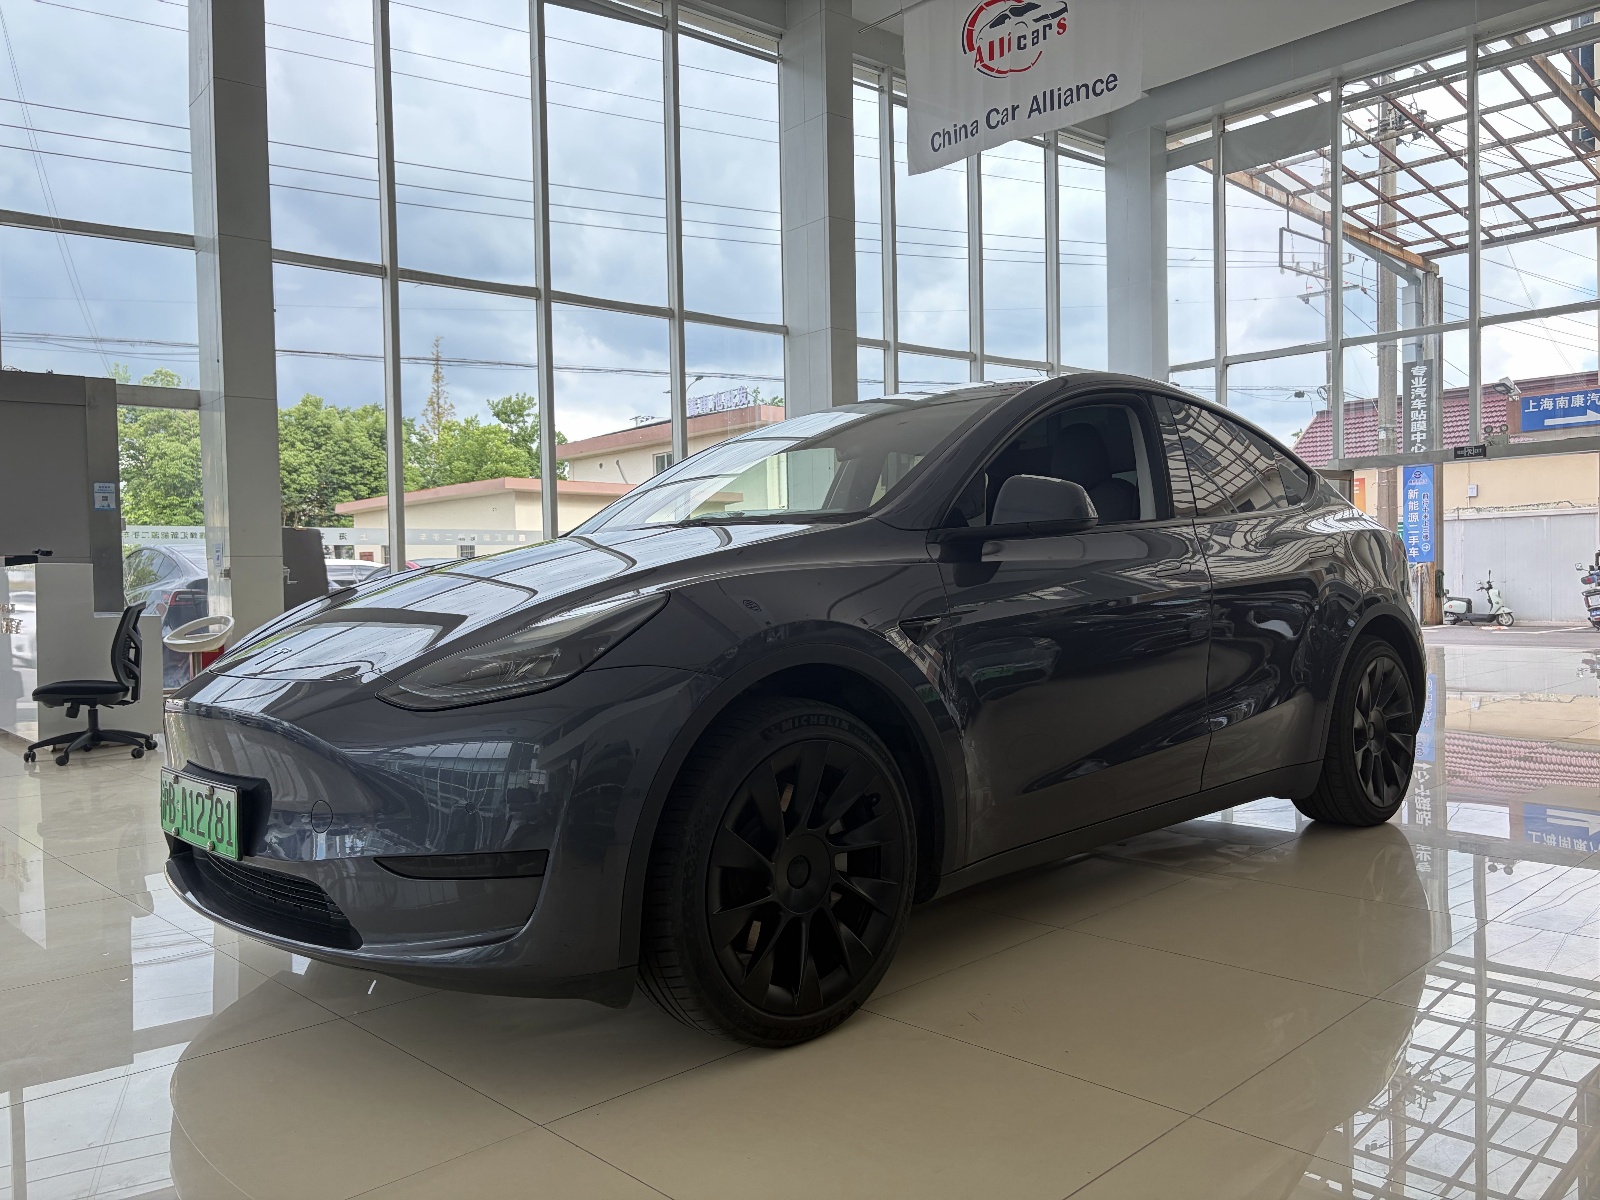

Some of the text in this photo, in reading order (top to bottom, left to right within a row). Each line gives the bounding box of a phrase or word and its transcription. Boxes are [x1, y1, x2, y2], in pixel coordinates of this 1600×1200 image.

[930, 73, 1119, 152] China Car Alliance
[1410, 365, 1427, 453] 专业汽车贴膜中心
[1524, 392, 1600, 413] 上海南康汽
[1407, 488, 1420, 558] 新能源二手车
[781, 714, 850, 732] MICHELIN
